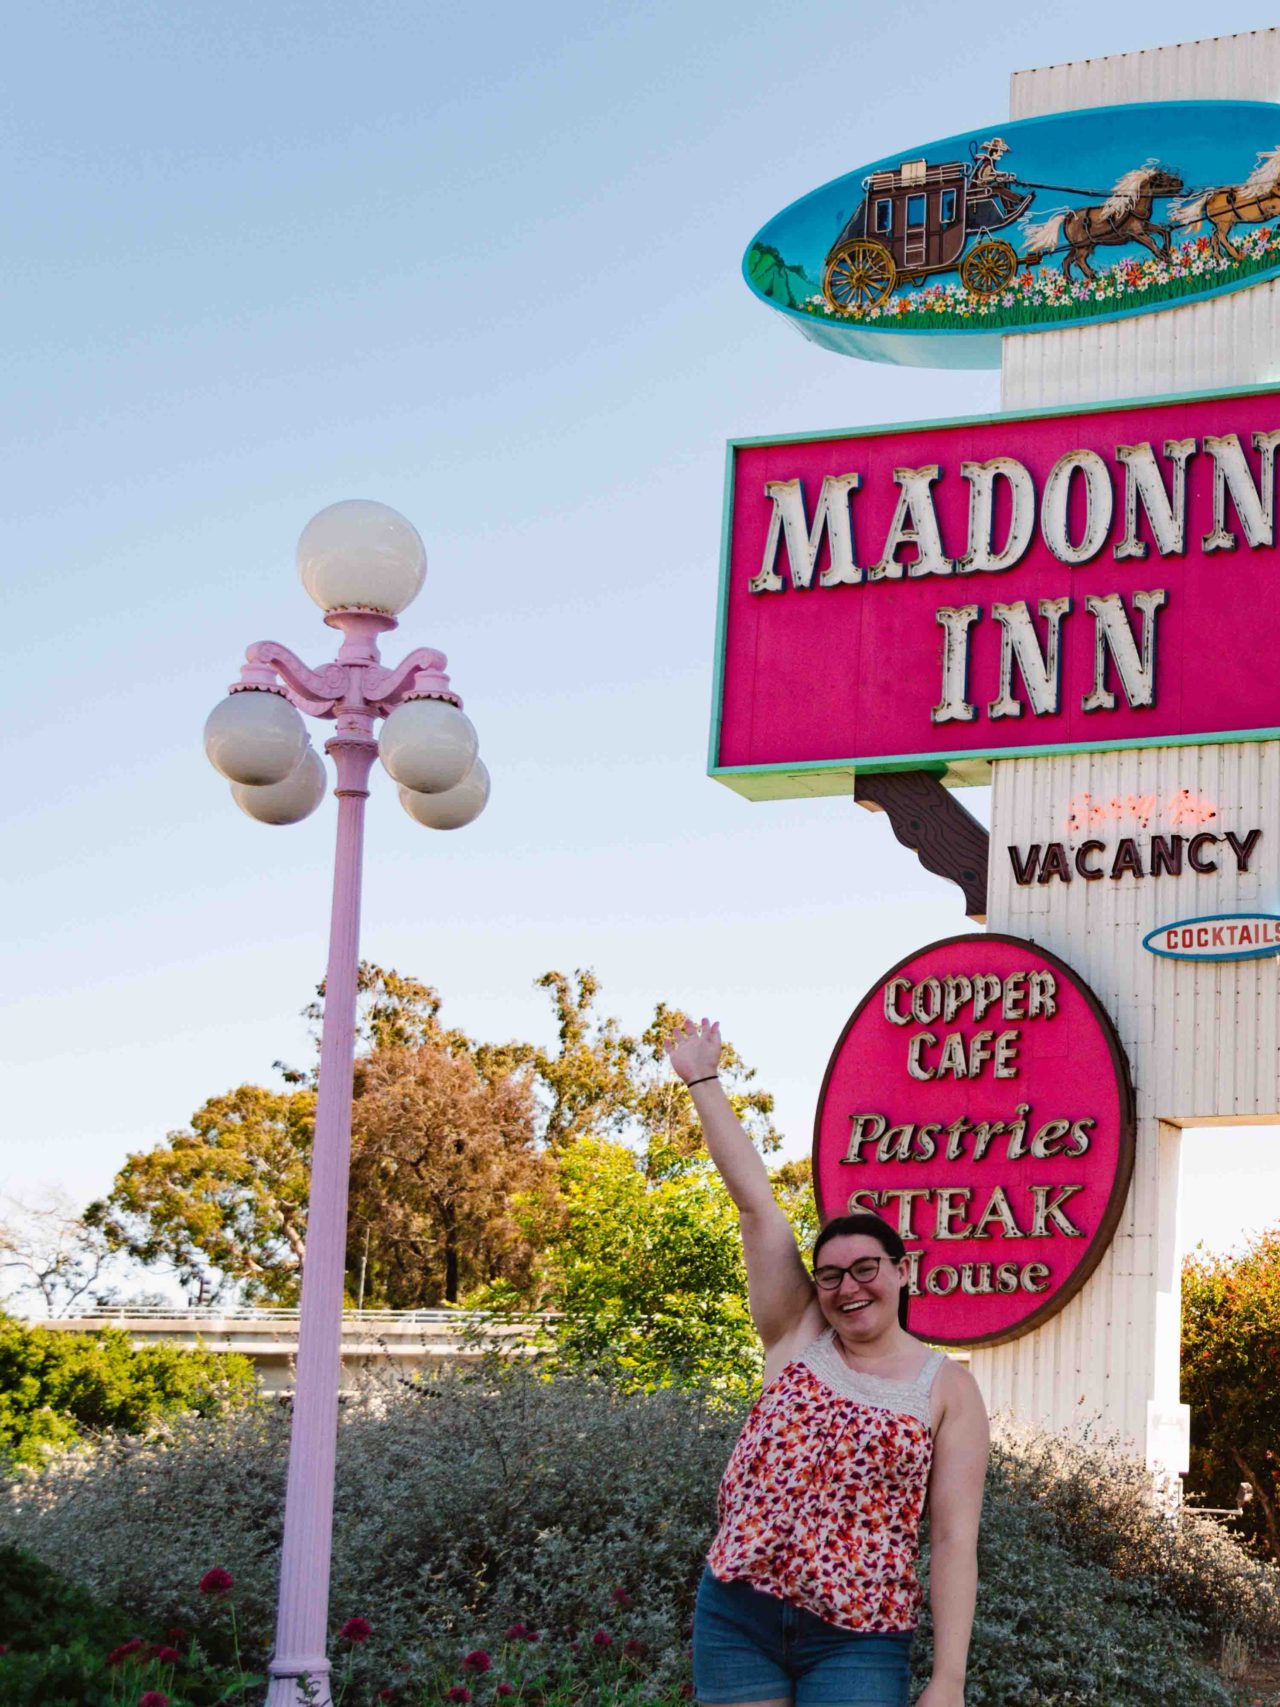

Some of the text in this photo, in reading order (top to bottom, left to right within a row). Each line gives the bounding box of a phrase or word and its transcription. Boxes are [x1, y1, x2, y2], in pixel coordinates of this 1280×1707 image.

[930, 588, 1169, 725] INN
[1008, 829, 1261, 885] VACANCY
[884, 970, 1057, 1026] COPPER
[907, 1030, 1021, 1081] CAFE
[838, 1103, 1096, 1165] Pastries
